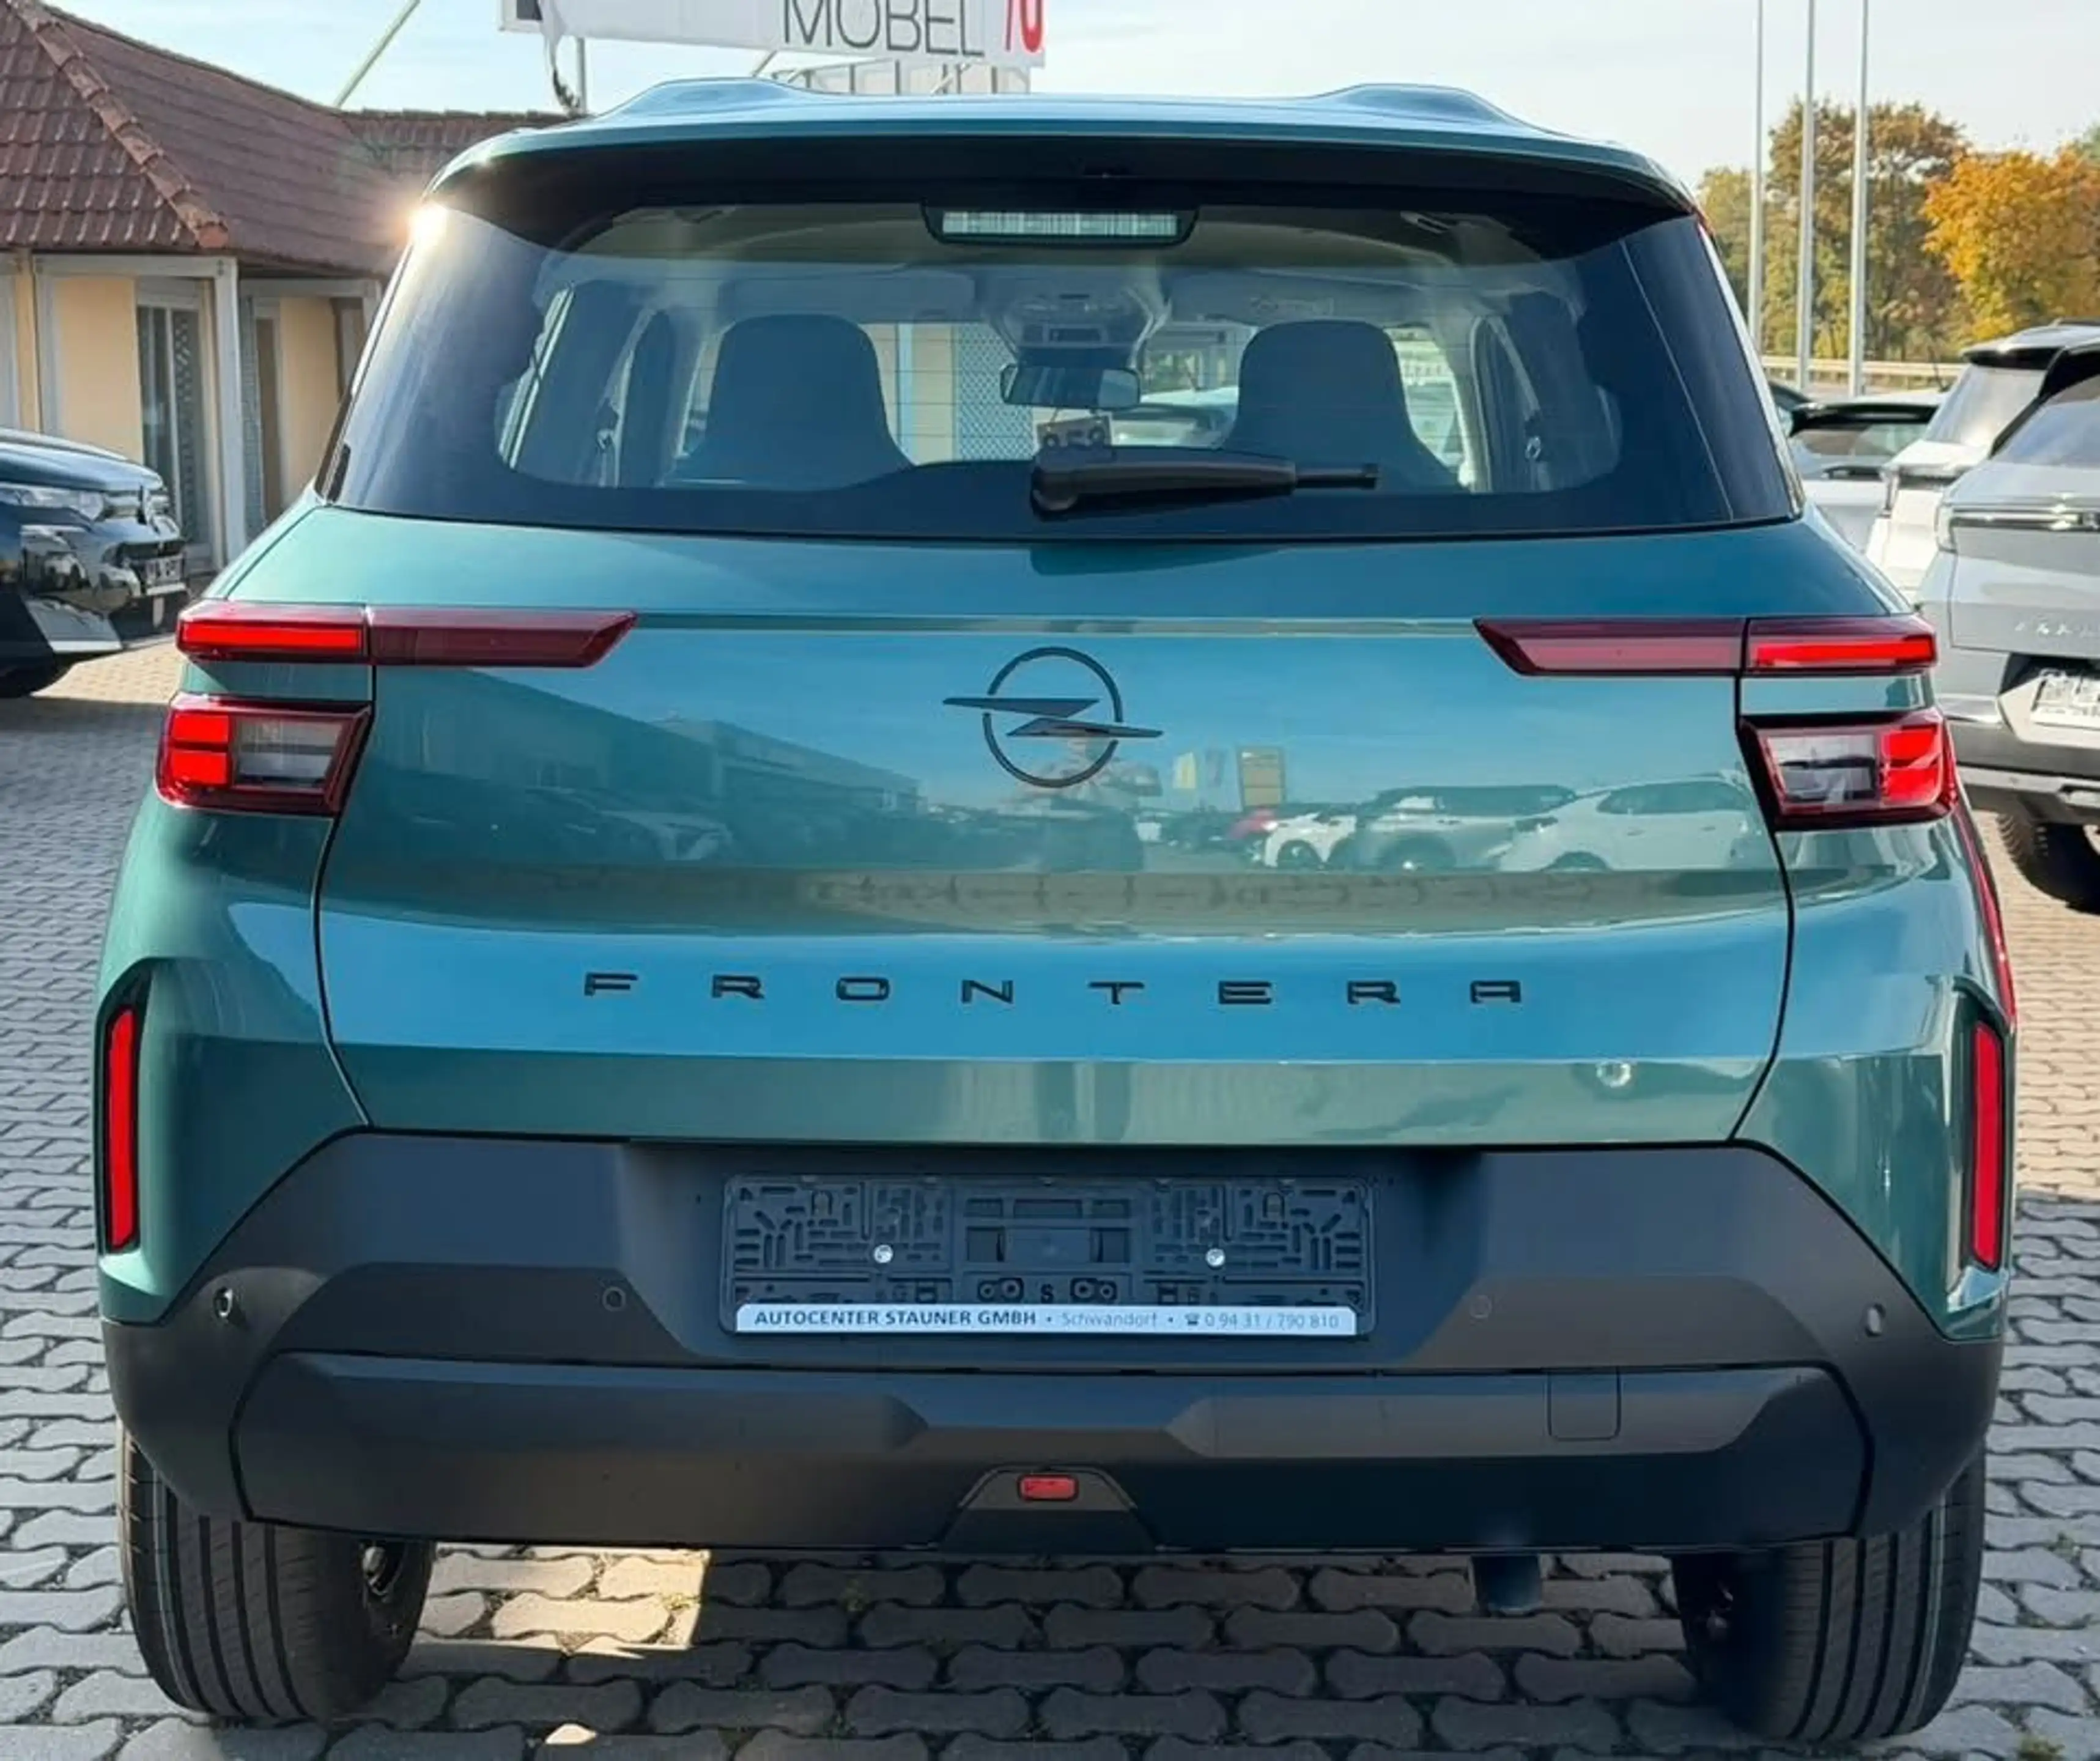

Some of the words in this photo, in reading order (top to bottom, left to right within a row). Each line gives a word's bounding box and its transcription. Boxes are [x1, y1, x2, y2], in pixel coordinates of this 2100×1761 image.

[583, 972, 1523, 1006] FRONTERA
[753, 1310, 879, 1326] AUTOCENTER
[885, 1310, 972, 1326] STAUNER
[977, 1310, 1037, 1326] GMBH
[1061, 1311, 1158, 1327] Schwandorf
